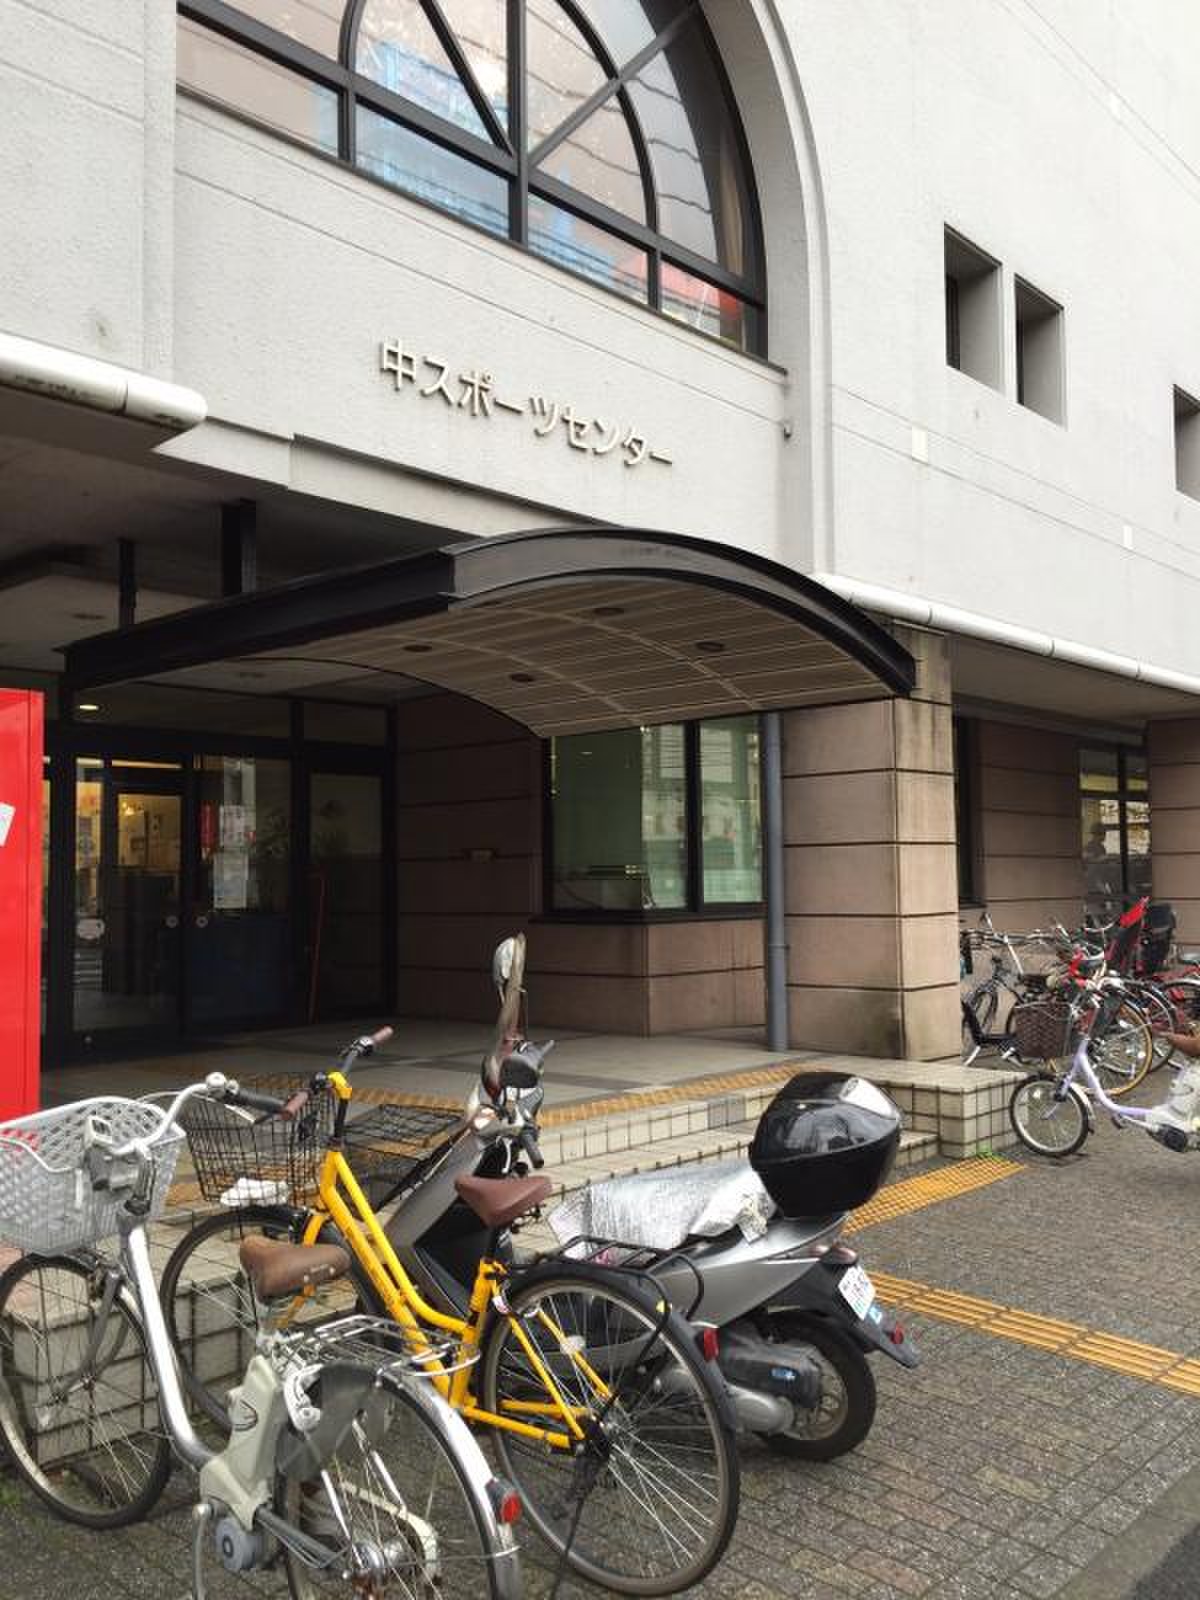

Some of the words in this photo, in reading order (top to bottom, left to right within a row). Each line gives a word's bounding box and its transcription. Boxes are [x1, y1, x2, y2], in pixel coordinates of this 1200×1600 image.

[380, 339, 673, 466] 中スポーツセンター
